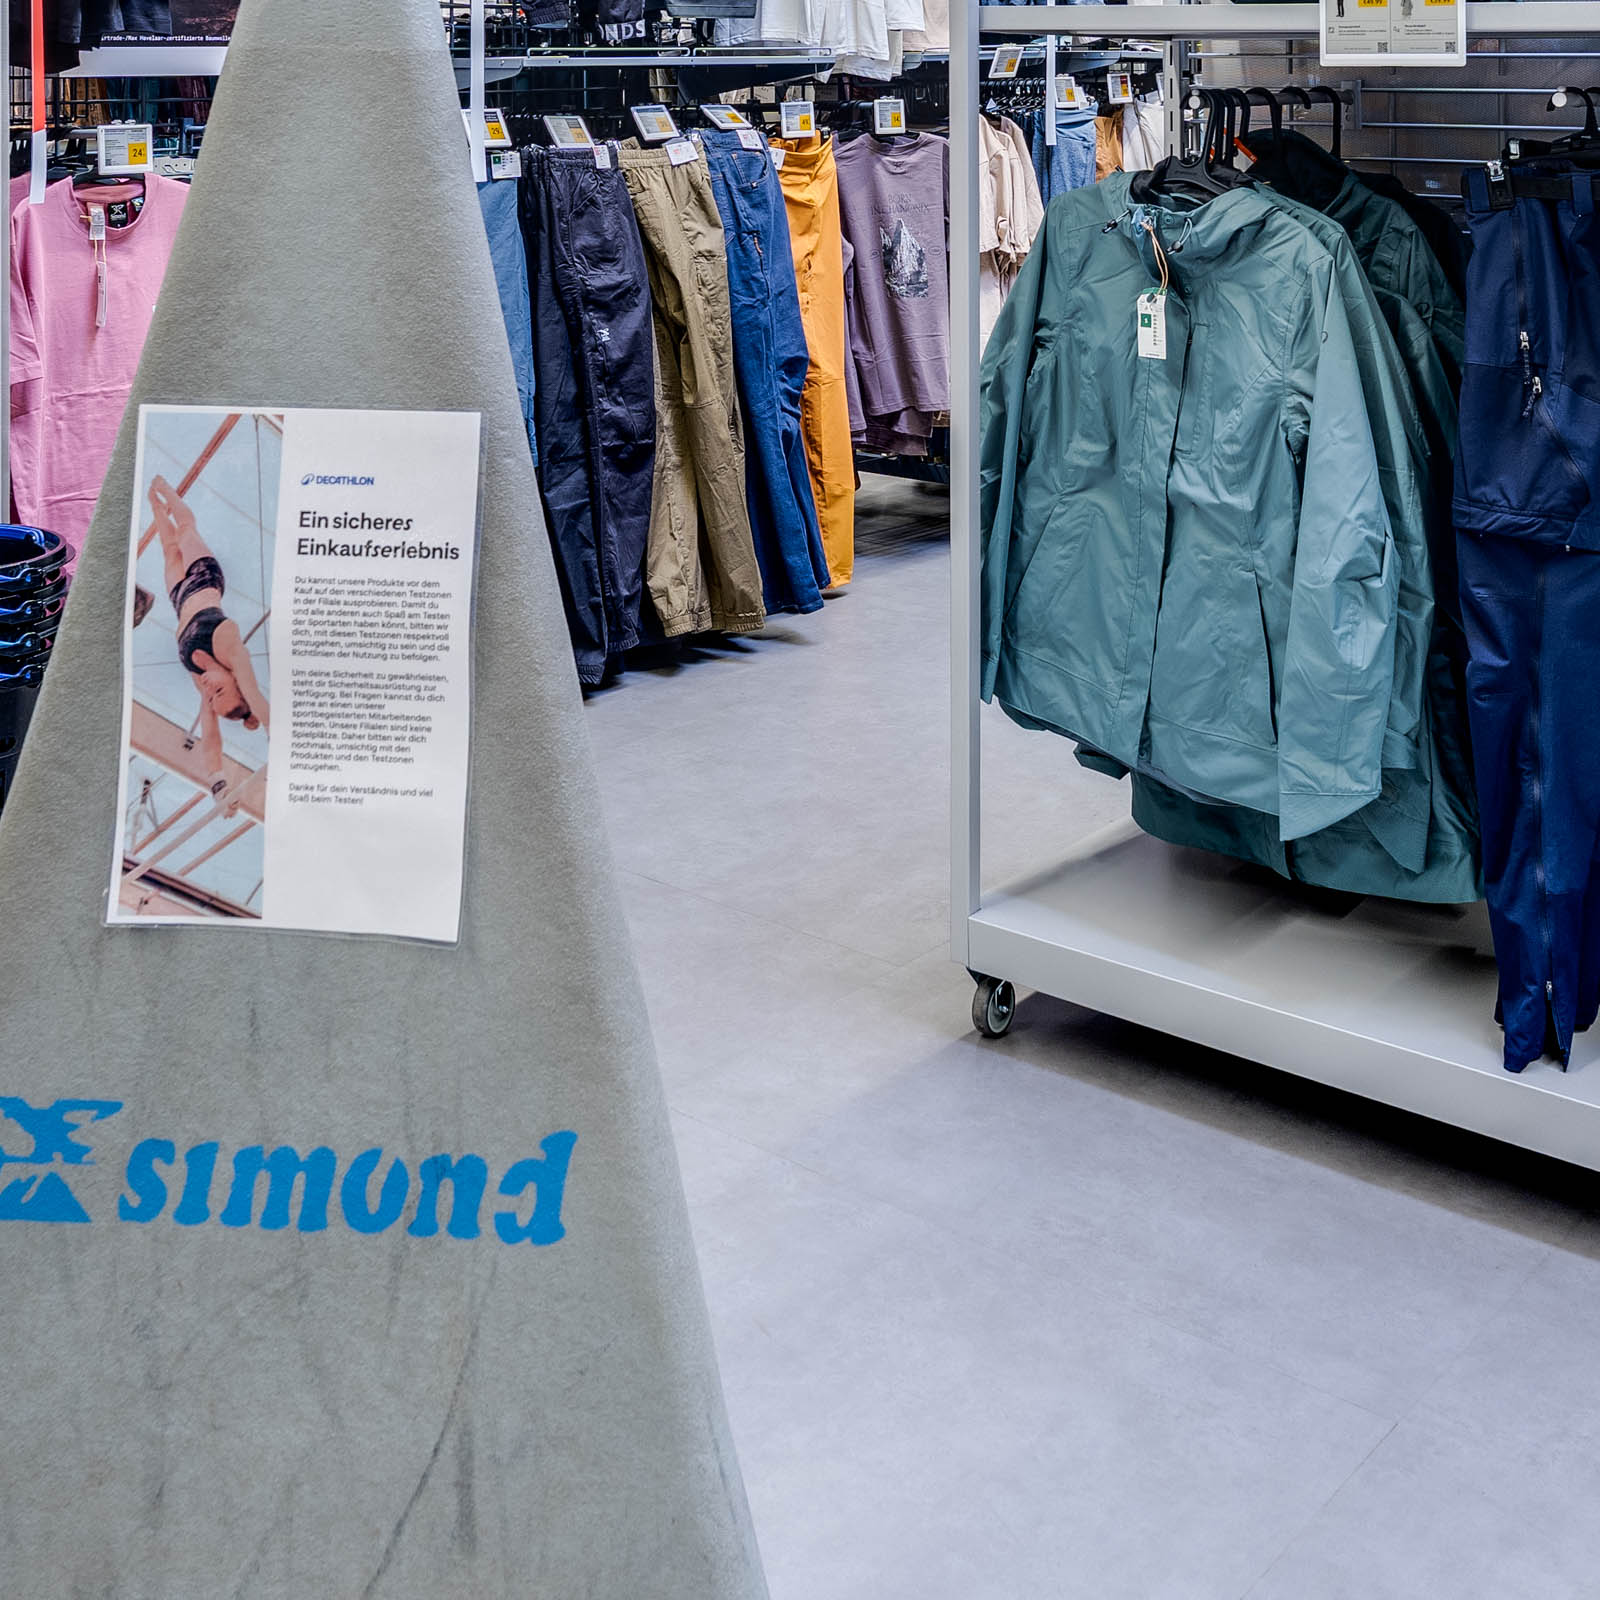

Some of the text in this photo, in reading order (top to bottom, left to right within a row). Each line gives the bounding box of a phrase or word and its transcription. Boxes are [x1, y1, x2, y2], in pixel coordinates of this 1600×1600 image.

[316, 475, 375, 486] DECATHLON
[300, 511, 414, 531] Ein sicheres
[298, 538, 460, 561] Einkaufserlebnis
[295, 576, 306, 584] Du
[368, 578, 404, 586] Produkte
[347, 589, 406, 597] verschiedenen
[410, 590, 452, 599] Testzonen
[401, 600, 425, 608] Damit
[311, 608, 324, 616] alle
[384, 611, 405, 619] Spaß
[424, 611, 450, 619] Testen
[308, 619, 352, 627] Sportarten
[381, 621, 407, 630] könnt,
[410, 622, 434, 630] bitten
[292, 629, 312, 637] dich,
[360, 631, 401, 639] Testzonen
[403, 633, 449, 641] respektvoll
[292, 640, 343, 648] umzugehen,
[345, 641, 386, 650] umsichtig
[437, 643, 450, 651] die
[292, 649, 335, 657] Richtlinien
[352, 651, 387, 660] Nutzung
[401, 653, 440, 662] befolgen.
[332, 670, 373, 679] Sicherheit
[388, 673, 448, 683] gewährleisten,
[328, 680, 421, 692] Sicherheitsausrüstung
[292, 690, 337, 699] Verfügung.
[354, 691, 382, 701] Fragen
[427, 694, 445, 702] dich
[292, 711, 432, 721] sportbegeisterten Mitarbeitenden
[360, 722, 388, 730] Filialen
[390, 723, 407, 731] sind
[410, 724, 432, 732] keine
[293, 730, 339, 739] Spielplätze.
[341, 732, 365, 740] Daher
[408, 734, 426, 742] dich
[292, 742, 334, 750] nochmals,
[336, 743, 377, 752] umsichtig
[291, 751, 333, 759] Produkten
[371, 755, 414, 763] Testzonen
[290, 763, 342, 772] umzugehen.
[290, 783, 314, 791] Danke
[350, 786, 398, 795] Verständnis
[419, 788, 433, 796] viel
[289, 794, 309, 802] Spaß
[335, 795, 363, 804] Testen!
[118, 1129, 578, 1247] simond
